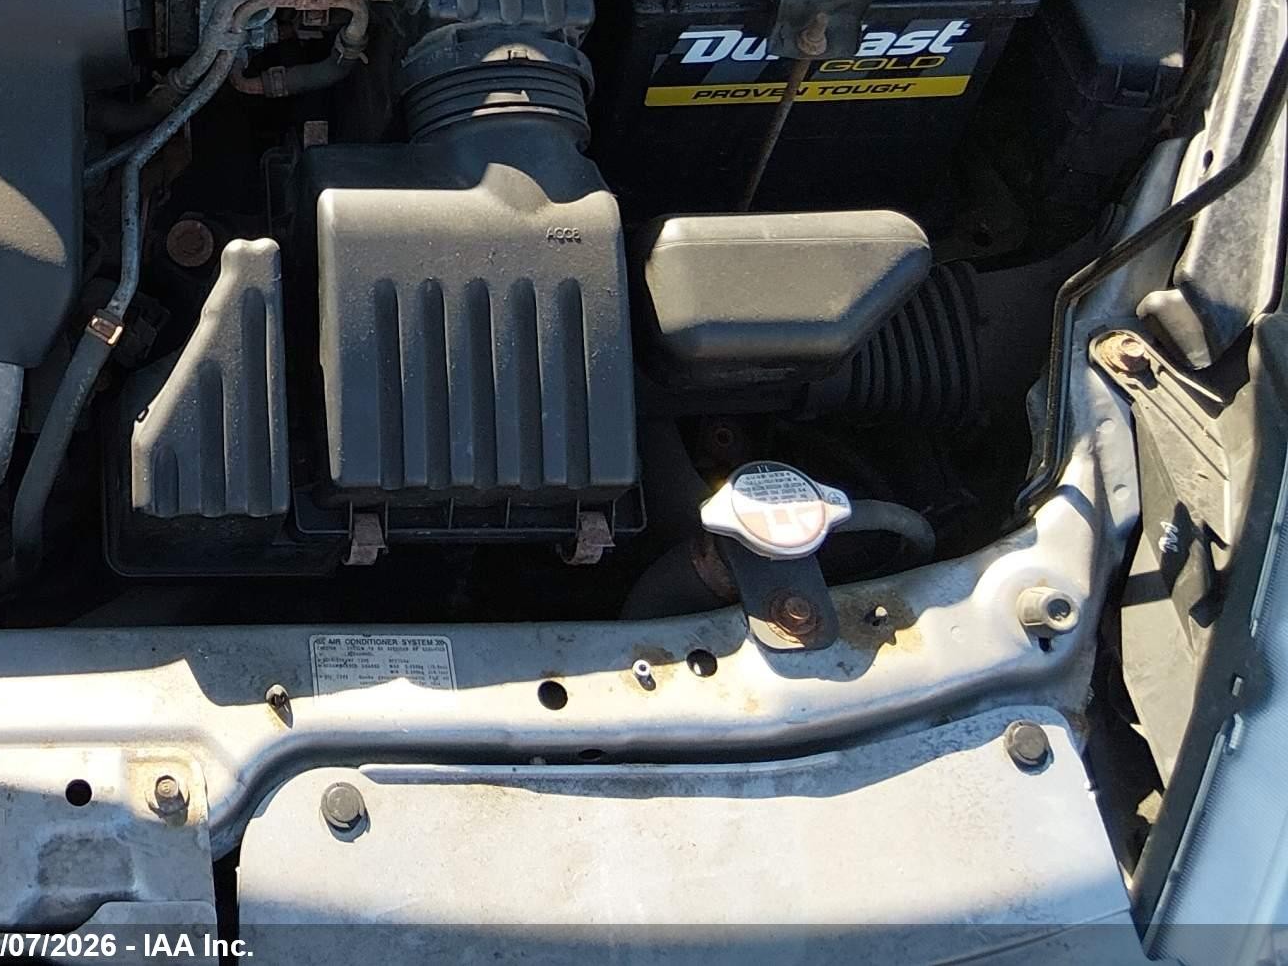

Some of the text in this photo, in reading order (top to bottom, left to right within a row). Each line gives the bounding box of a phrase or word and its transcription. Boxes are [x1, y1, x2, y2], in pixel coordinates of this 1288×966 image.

[678, 20, 972, 63] Duast
[819, 56, 945, 72] GOLD
[692, 83, 914, 100] PROVEN TOUGH
[345, 638, 398, 646] CONDITIONER
